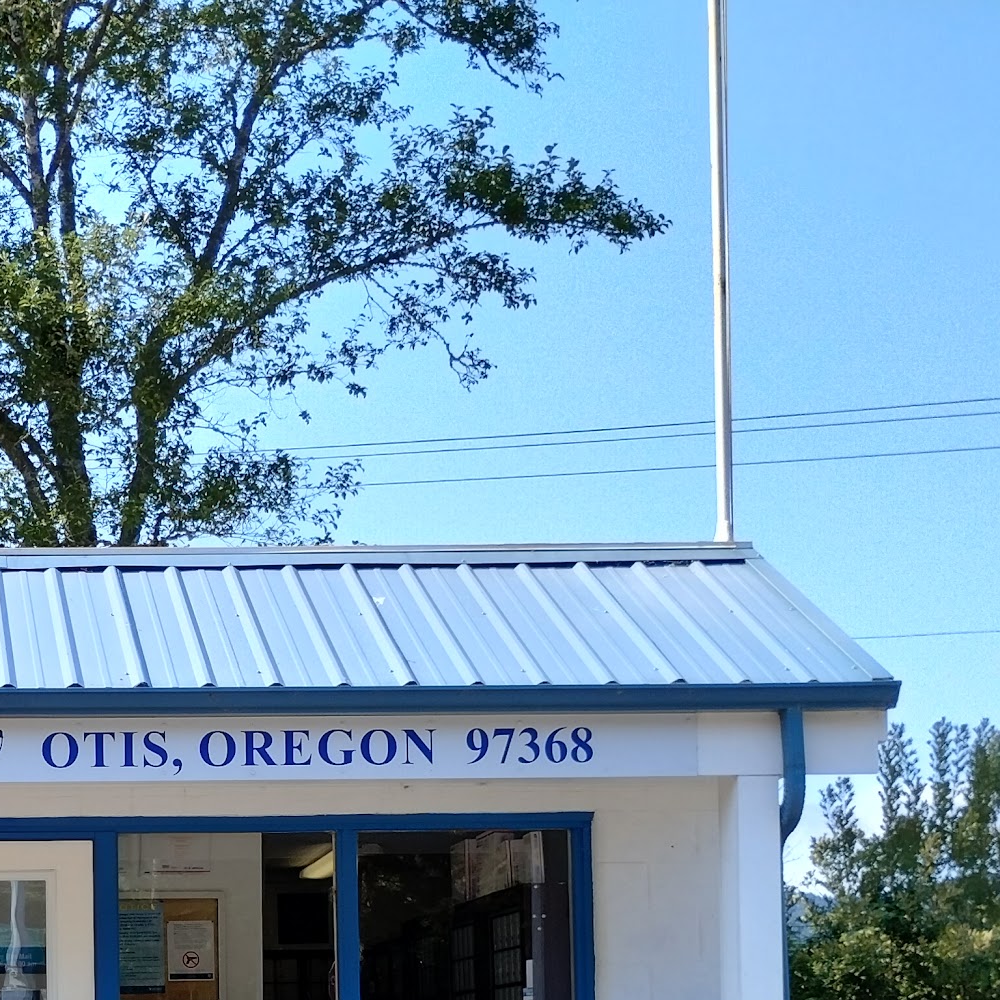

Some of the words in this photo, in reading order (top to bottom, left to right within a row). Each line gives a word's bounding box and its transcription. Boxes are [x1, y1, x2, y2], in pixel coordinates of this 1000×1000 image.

[41, 730, 183, 776] OTIS,
[199, 728, 437, 767] OREGON
[466, 726, 594, 765] 97368
